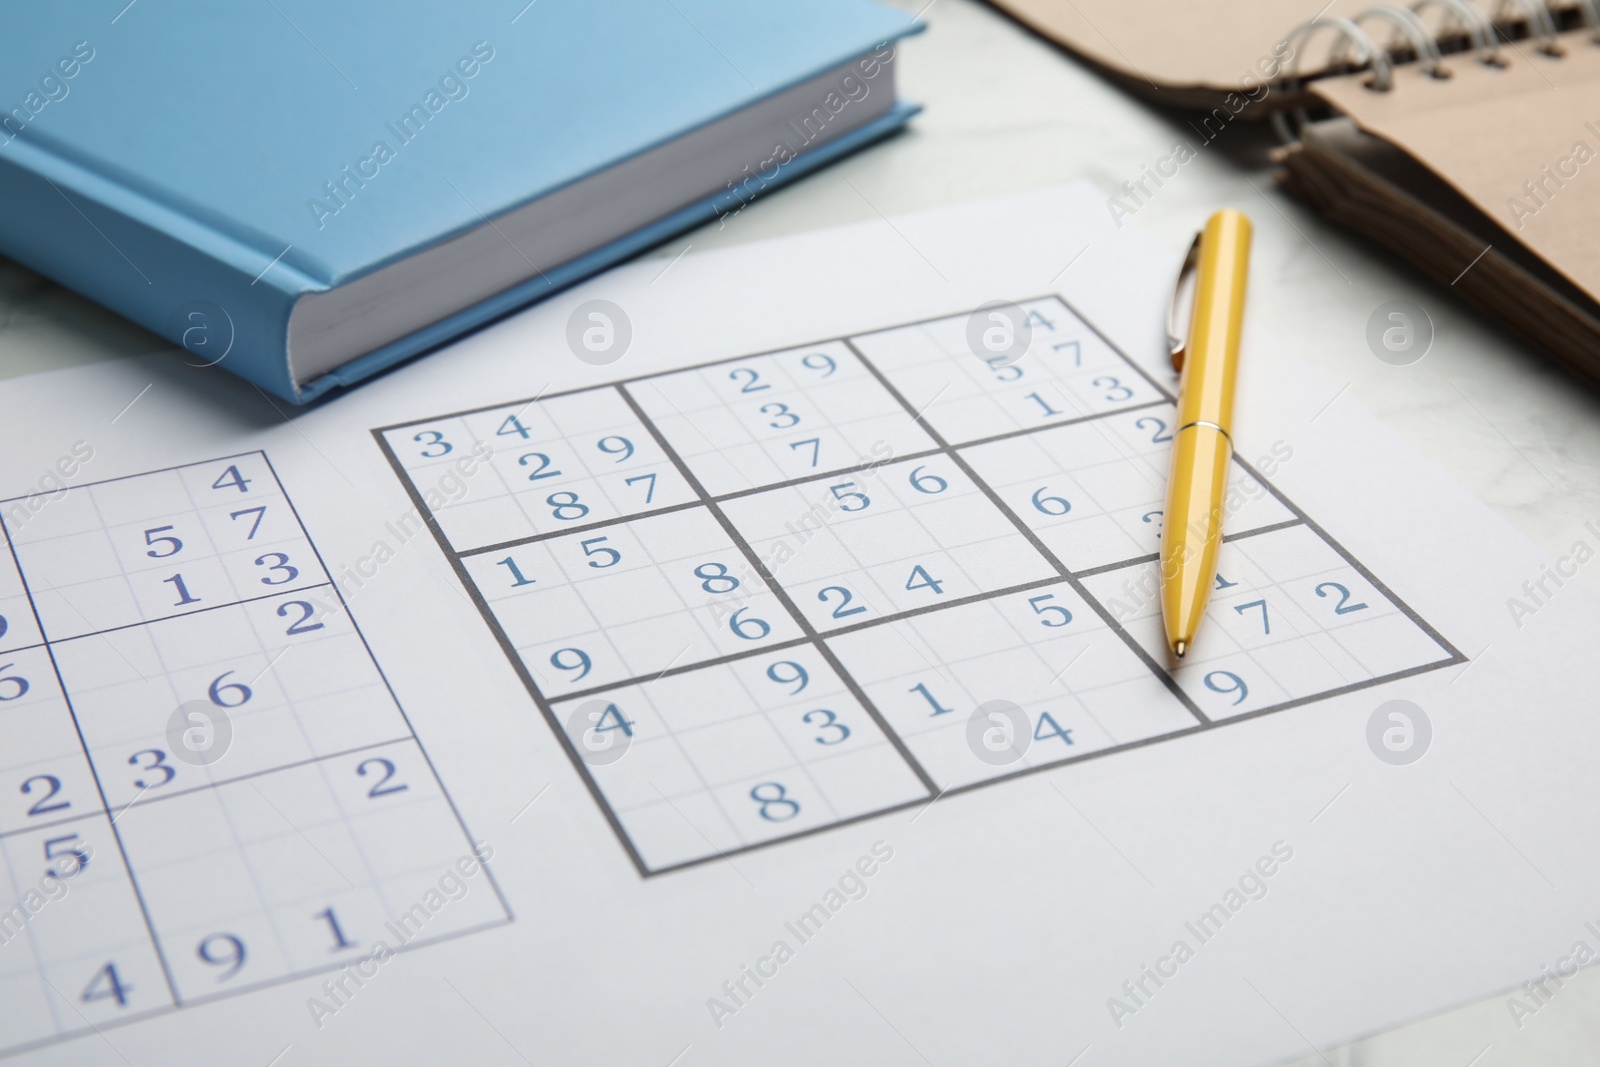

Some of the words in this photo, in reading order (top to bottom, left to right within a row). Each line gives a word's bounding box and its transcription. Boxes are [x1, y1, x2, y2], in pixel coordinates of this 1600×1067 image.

[1025, 310, 1055, 333] 4
[803, 354, 837, 378] 9
[985, 356, 1025, 381] 5
[1050, 339, 1082, 369] 7
[730, 368, 771, 394] 2
[1093, 377, 1134, 401] 3
[760, 403, 800, 429] 3
[1026, 393, 1062, 417] 1
[413, 430, 454, 458] 3
[496, 414, 530, 441] 4
[1134, 416, 1174, 445] 2
[597, 436, 635, 463] 9
[789, 437, 822, 469] 7
[212, 464, 253, 494] 4
[519, 452, 562, 482] 2
[908, 466, 949, 495] 6
[625, 472, 658, 505] 7
[830, 481, 872, 511] 5
[1030, 488, 1072, 517] 6
[546, 491, 591, 521] 8
[231, 505, 269, 541] 7
[145, 524, 186, 557] 5
[580, 536, 623, 569] 5
[255, 552, 300, 585] 3
[498, 555, 538, 588] 1
[693, 562, 741, 595] 8
[905, 565, 945, 595] 4
[164, 573, 202, 607] 1
[817, 585, 868, 620] 2
[1313, 581, 1369, 616] 2
[277, 600, 327, 636] 2
[729, 607, 772, 641] 6
[1027, 593, 1073, 628] 5
[1233, 598, 1271, 638] 7
[550, 648, 592, 682] 9
[766, 659, 810, 693] 9
[209, 671, 253, 707] 6
[908, 683, 954, 717] 1
[1202, 671, 1249, 706] 9
[595, 704, 636, 738] 4
[804, 708, 851, 745] 3
[1032, 710, 1073, 746] 4
[128, 749, 177, 790] 3
[357, 758, 408, 798] 2
[20, 774, 73, 816] 2
[750, 781, 801, 822] 8
[44, 833, 90, 879] 5
[314, 907, 359, 953] 1
[197, 933, 248, 984] 9
[80, 962, 135, 1008] 4
